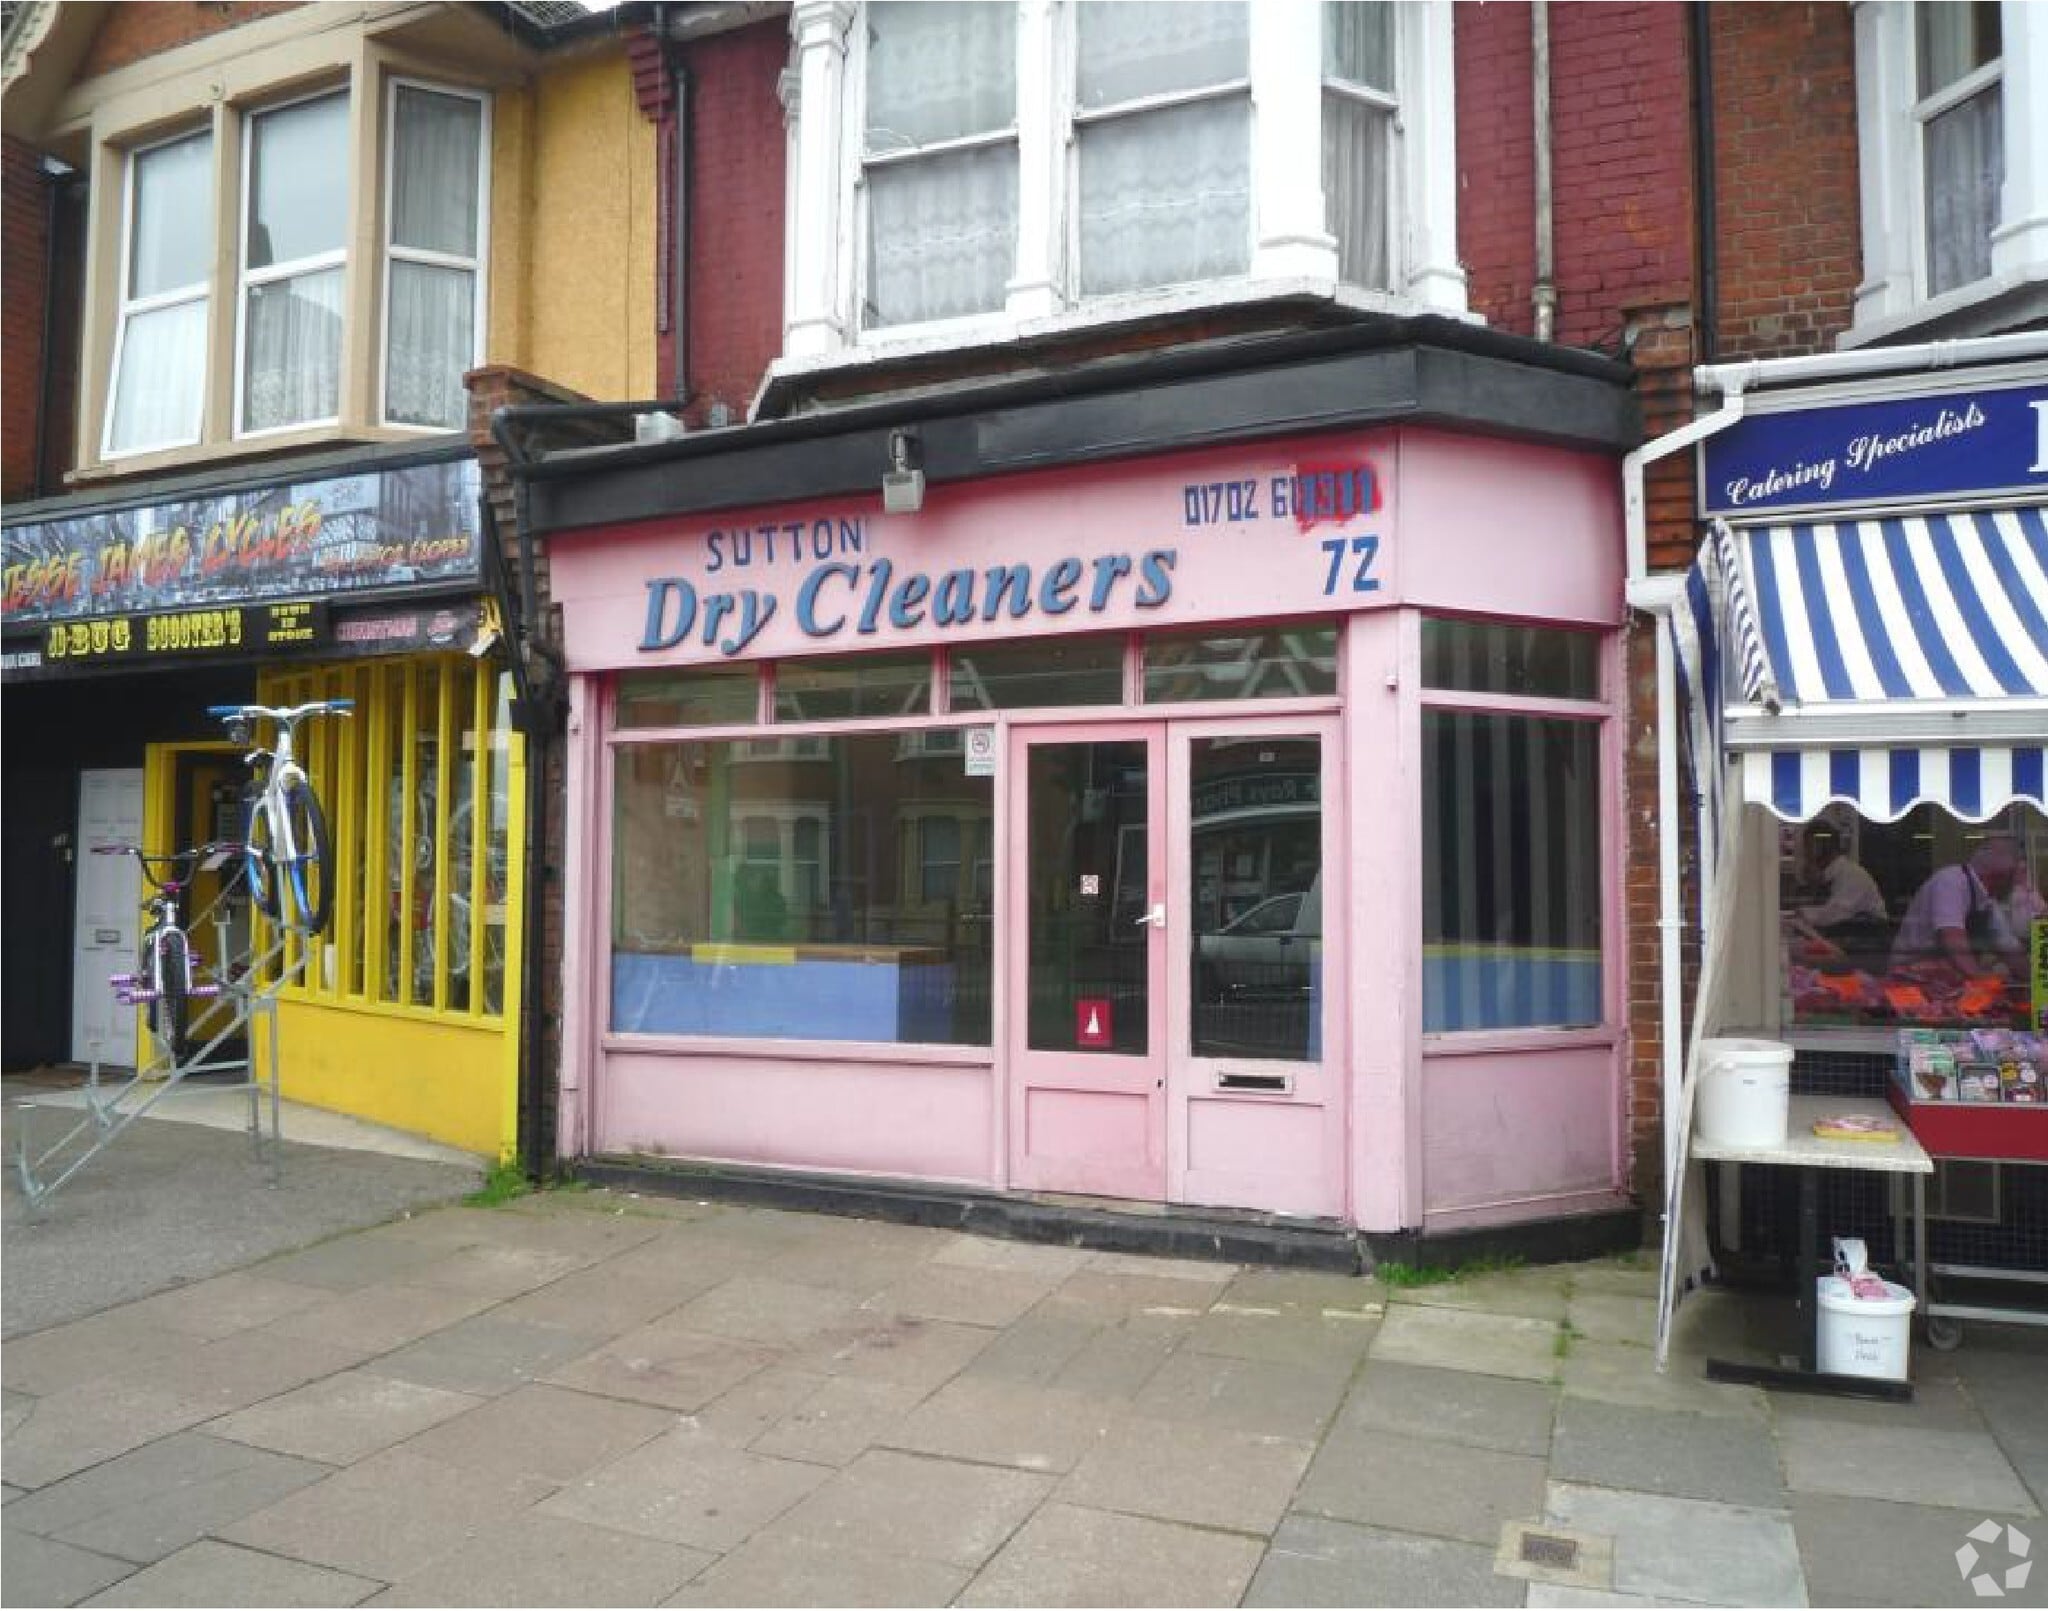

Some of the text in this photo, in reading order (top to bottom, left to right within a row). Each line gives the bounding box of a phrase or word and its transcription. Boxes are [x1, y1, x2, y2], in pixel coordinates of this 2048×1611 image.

[1726, 458, 1836, 505] Catering
[1845, 401, 1986, 473] Specialists
[1184, 478, 1259, 526] 01702
[705, 517, 865, 572] SUTTON
[1321, 534, 1380, 596] 72
[637, 548, 1178, 656] Dry Cleaners
